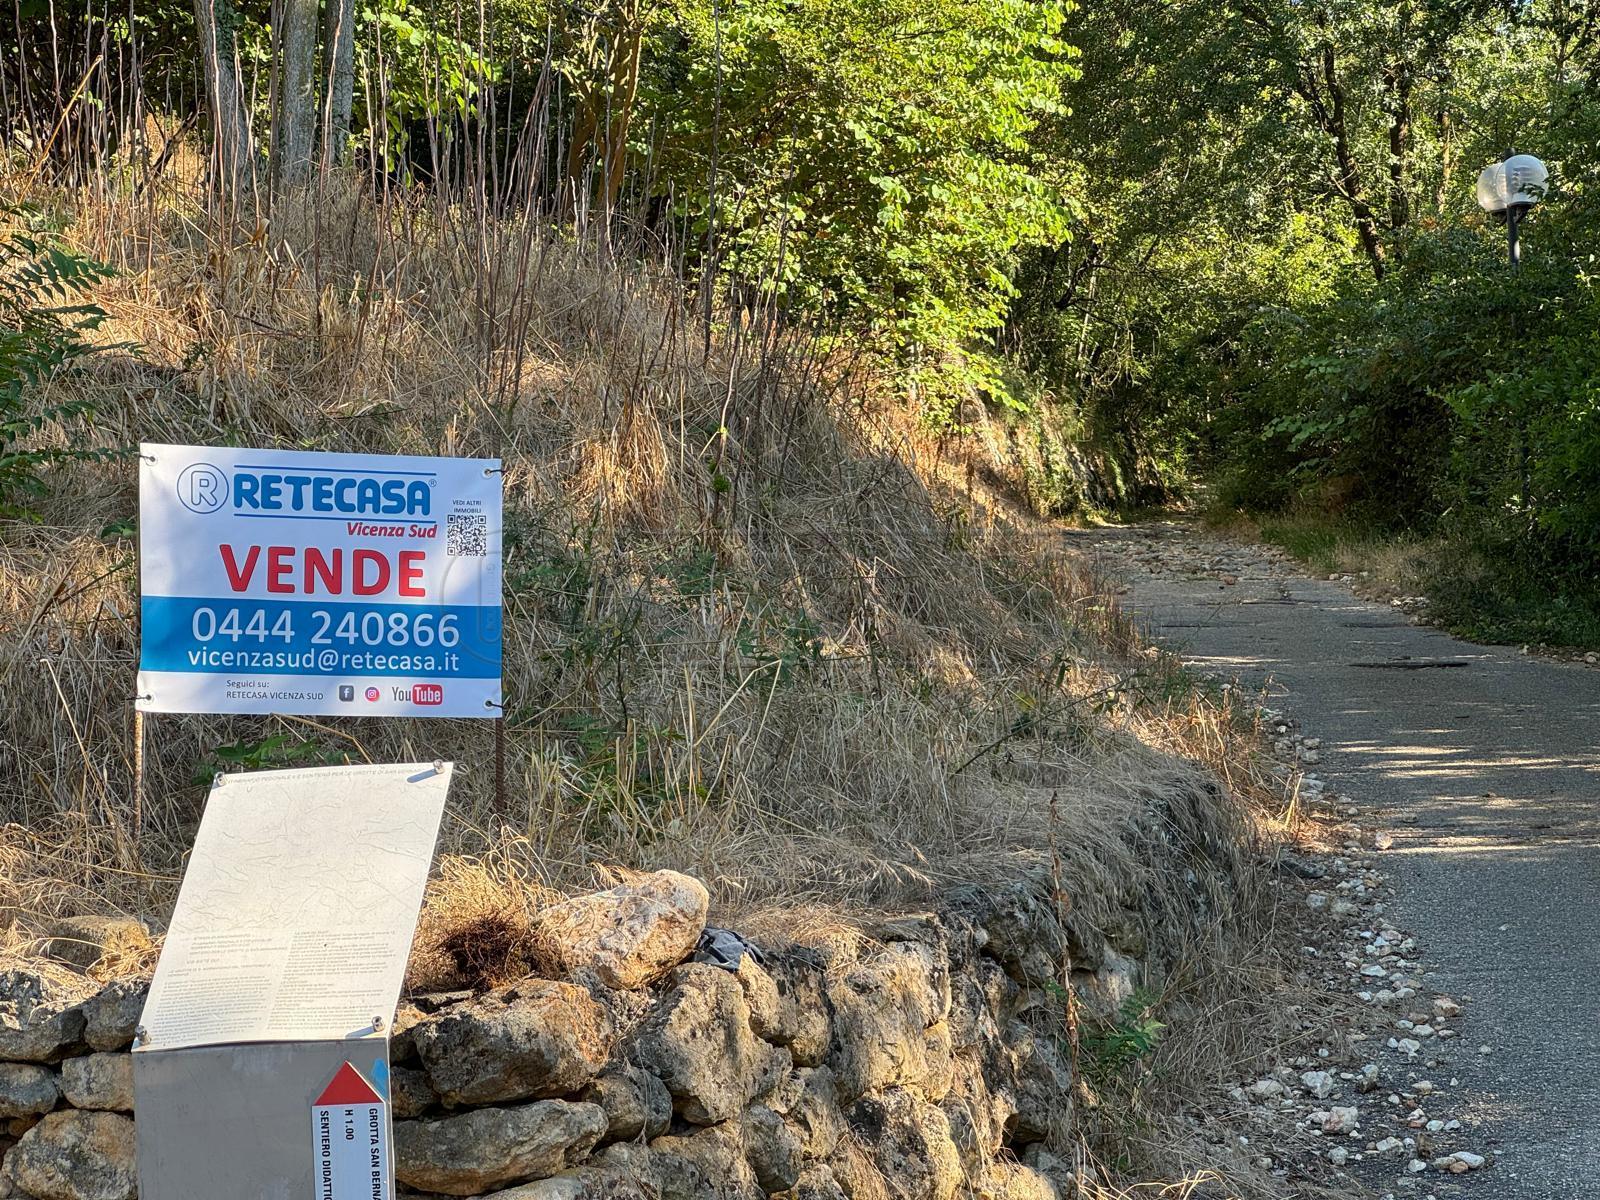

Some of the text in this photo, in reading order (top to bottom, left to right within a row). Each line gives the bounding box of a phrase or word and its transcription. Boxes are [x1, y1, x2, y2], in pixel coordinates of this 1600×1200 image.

[466, 499, 482, 507] ALTRI
[347, 521, 437, 538] Vicenza Sud
[219, 544, 426, 597] VENDE
[192, 607, 460, 647] 0444 240866
[187, 646, 460, 671] vicenzasud@retecasa.it
[226, 679, 256, 689] Seguici
[391, 685, 441, 703] YouTube
[226, 690, 268, 699] RETECASA
[269, 692, 305, 700] VICENZA
[320, 1110, 331, 1157] SENTIERO
[345, 1119, 354, 1140] 1.00
[369, 1108, 379, 1145] GROTTA
[370, 1147, 380, 1168] SAN
